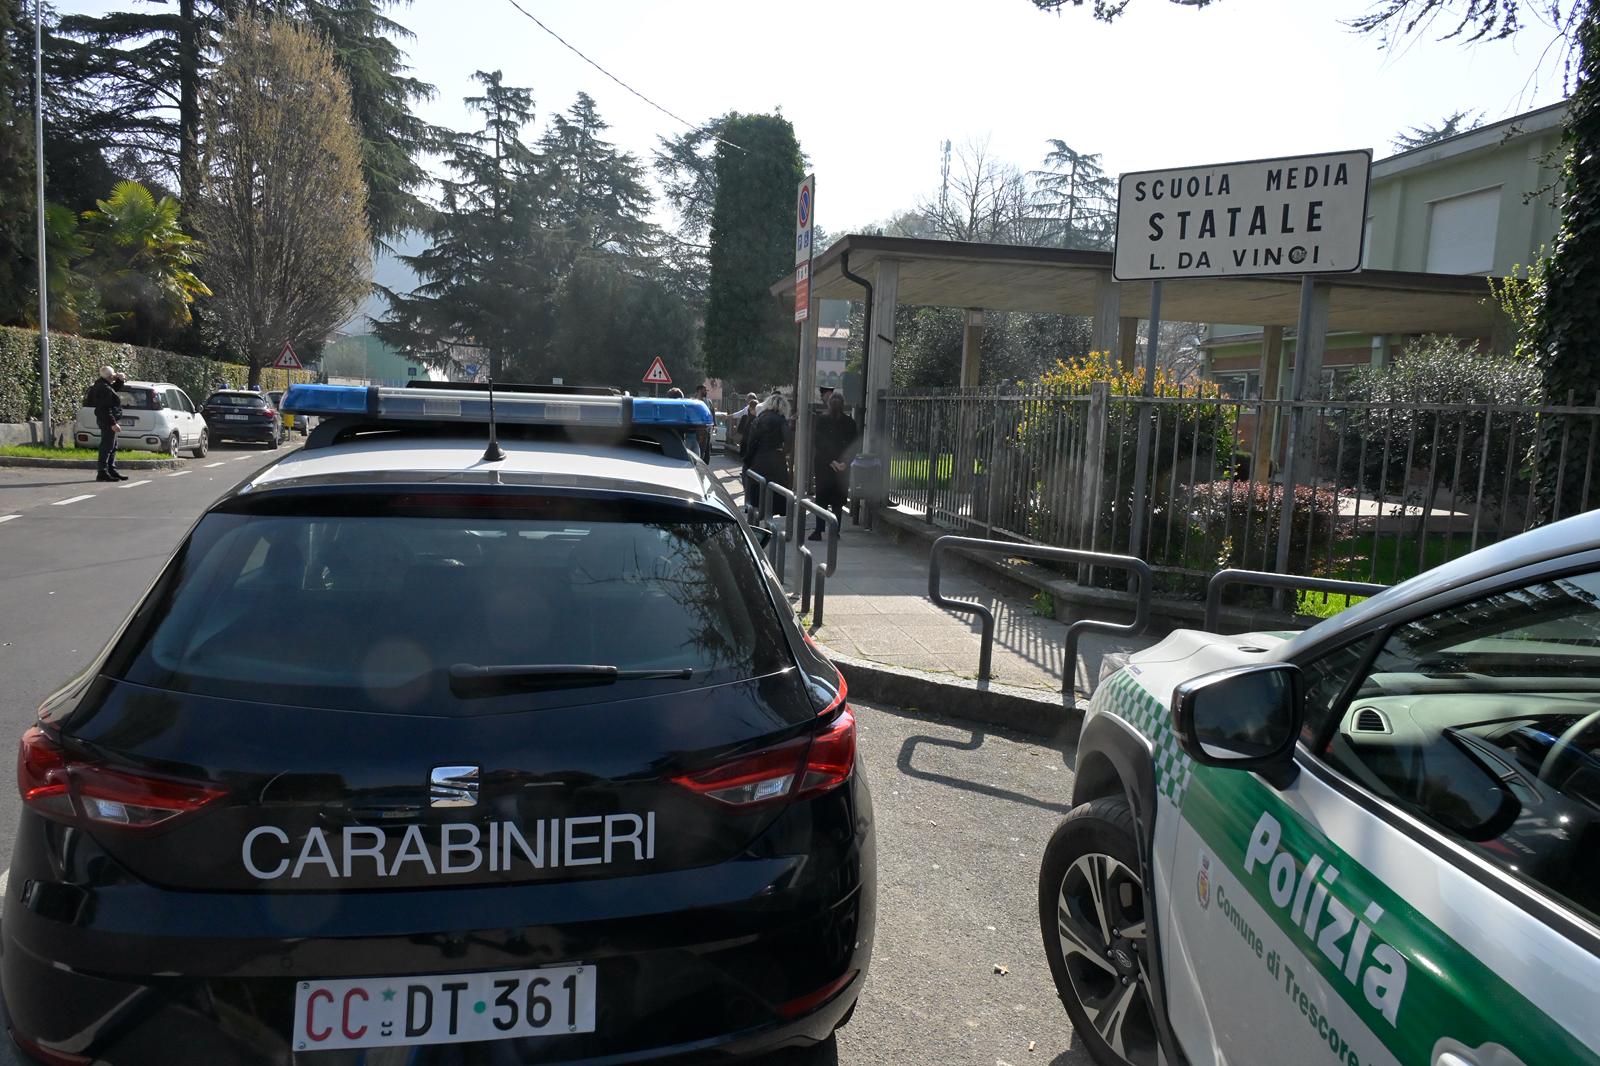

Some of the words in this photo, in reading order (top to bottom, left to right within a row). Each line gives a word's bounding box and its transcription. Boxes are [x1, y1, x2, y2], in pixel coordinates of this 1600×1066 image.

[1135, 174, 1231, 202] SCUOLA
[1266, 163, 1348, 191] MEDIA
[1148, 201, 1323, 242] STATALE
[1150, 253, 1165, 270] L.
[1178, 251, 1211, 269] DA
[242, 811, 656, 879] CARABINIERI
[1244, 810, 1408, 1029] Polizia
[306, 987, 369, 1042] CC
[405, 982, 468, 1037] DT
[492, 974, 578, 1031] 361
[1217, 885, 1263, 959] Comune
[1267, 950, 1281, 981] di
[1284, 964, 1359, 1066] Trescore
